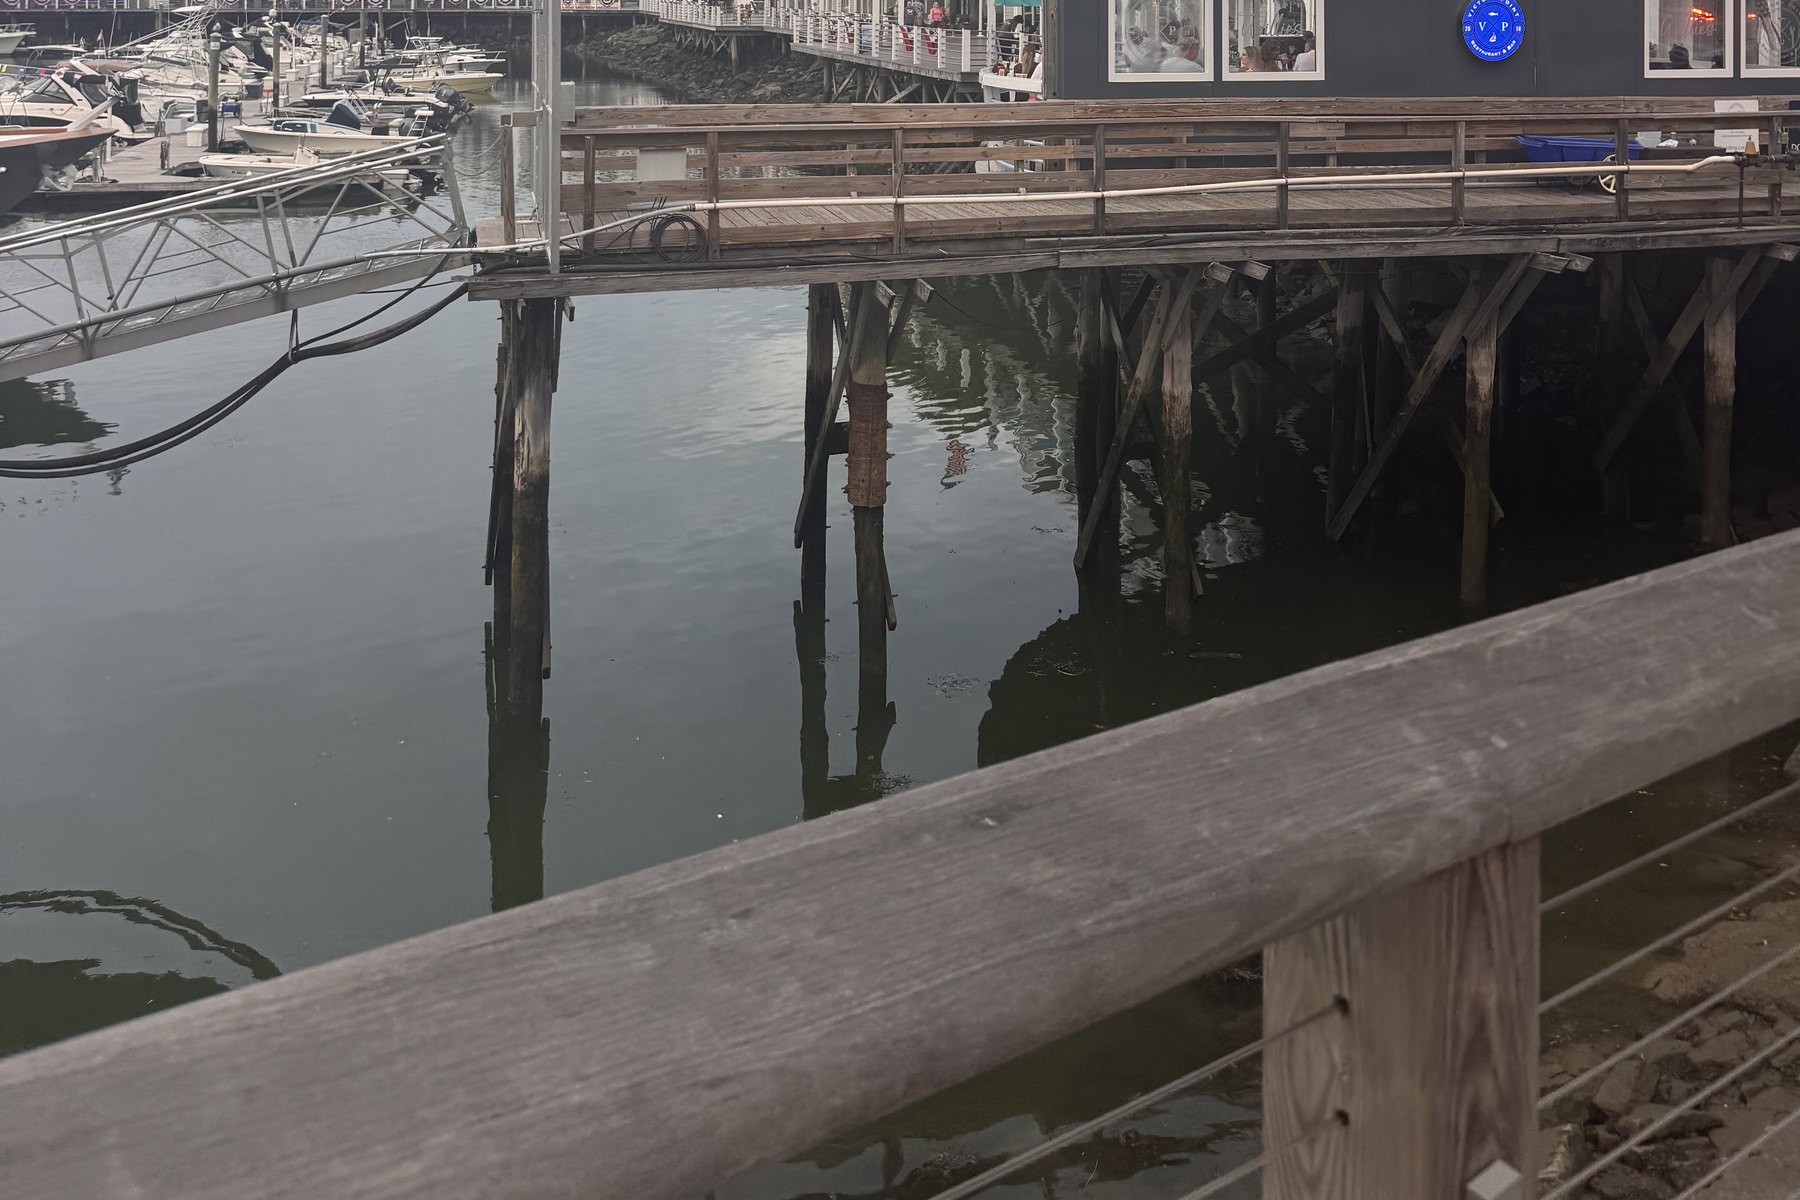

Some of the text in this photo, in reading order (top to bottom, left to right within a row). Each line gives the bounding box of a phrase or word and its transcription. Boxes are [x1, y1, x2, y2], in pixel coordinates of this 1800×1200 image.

[1478, 21, 1509, 31] V P
[1470, 40, 1501, 57] RESTAURANT
